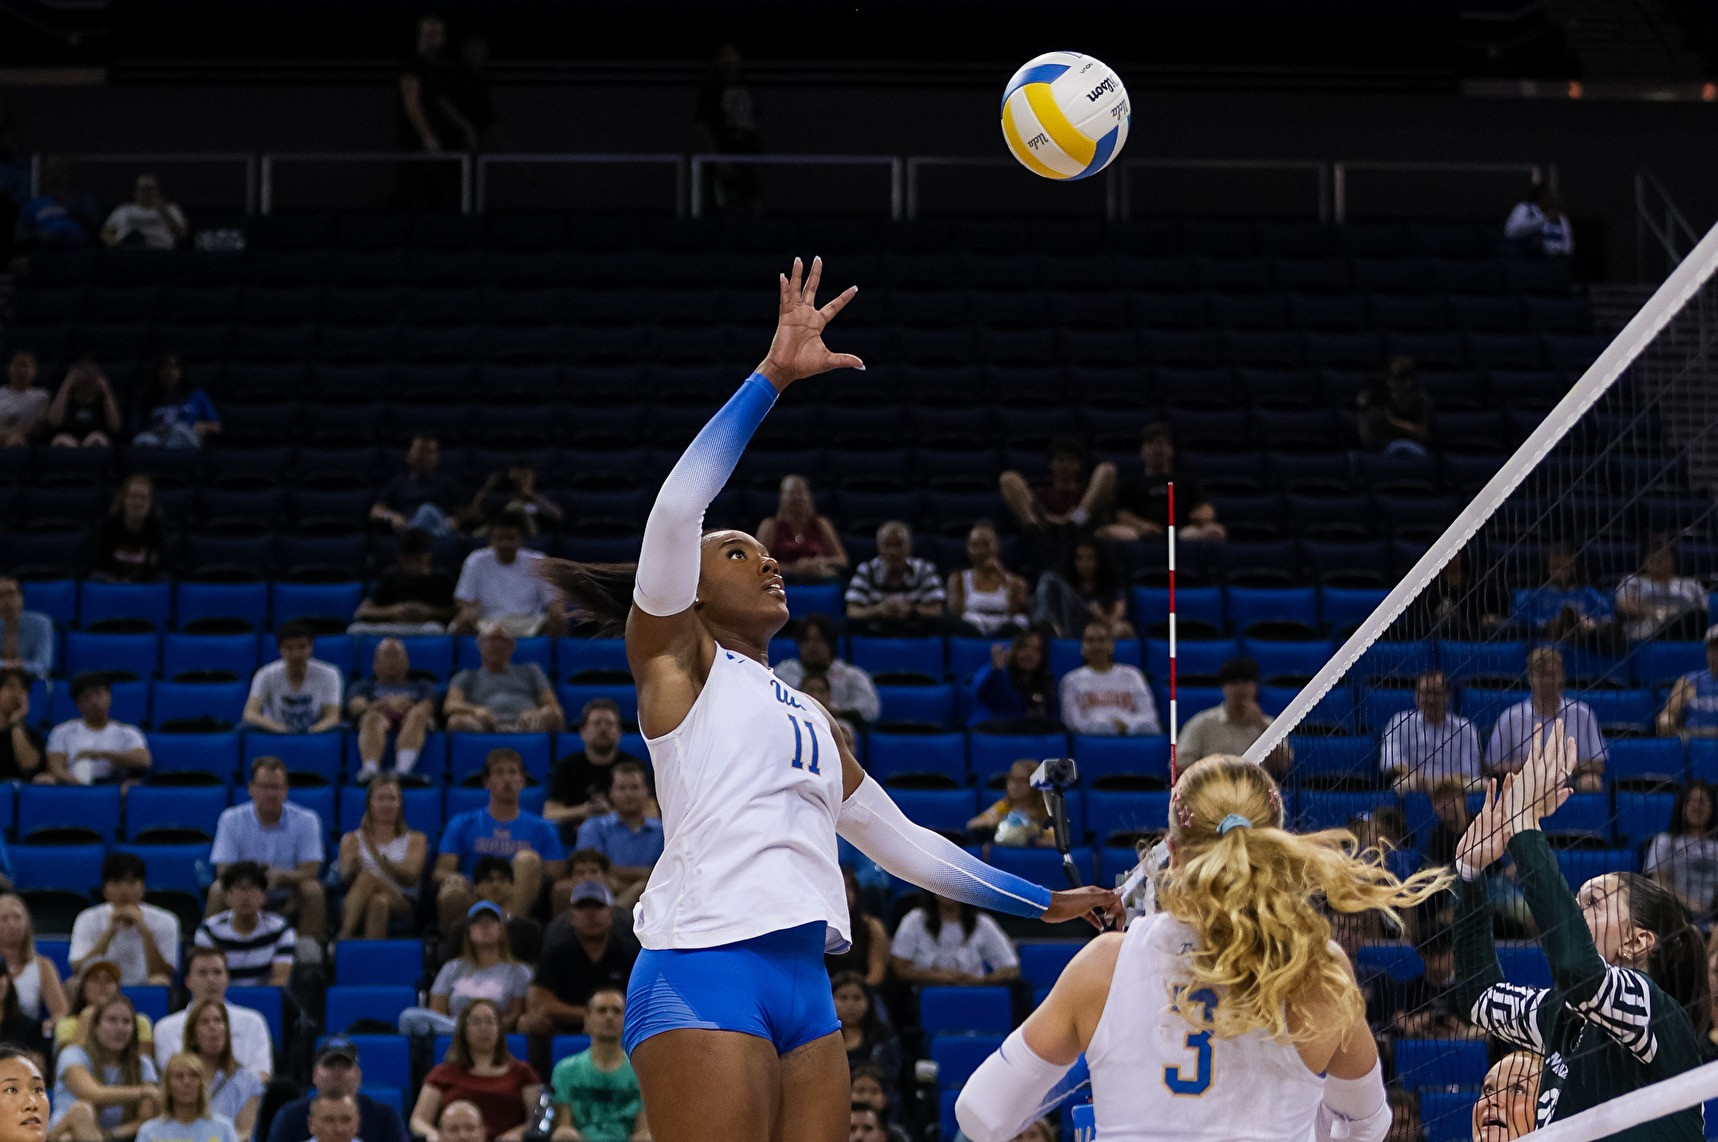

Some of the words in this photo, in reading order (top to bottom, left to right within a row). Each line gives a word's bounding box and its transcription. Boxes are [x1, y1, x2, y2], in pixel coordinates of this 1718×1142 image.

[1086, 75, 1118, 102] ilson
[1028, 132, 1049, 150] Ucla
[787, 713, 821, 776] 11
[1162, 983, 1219, 1097] 3
